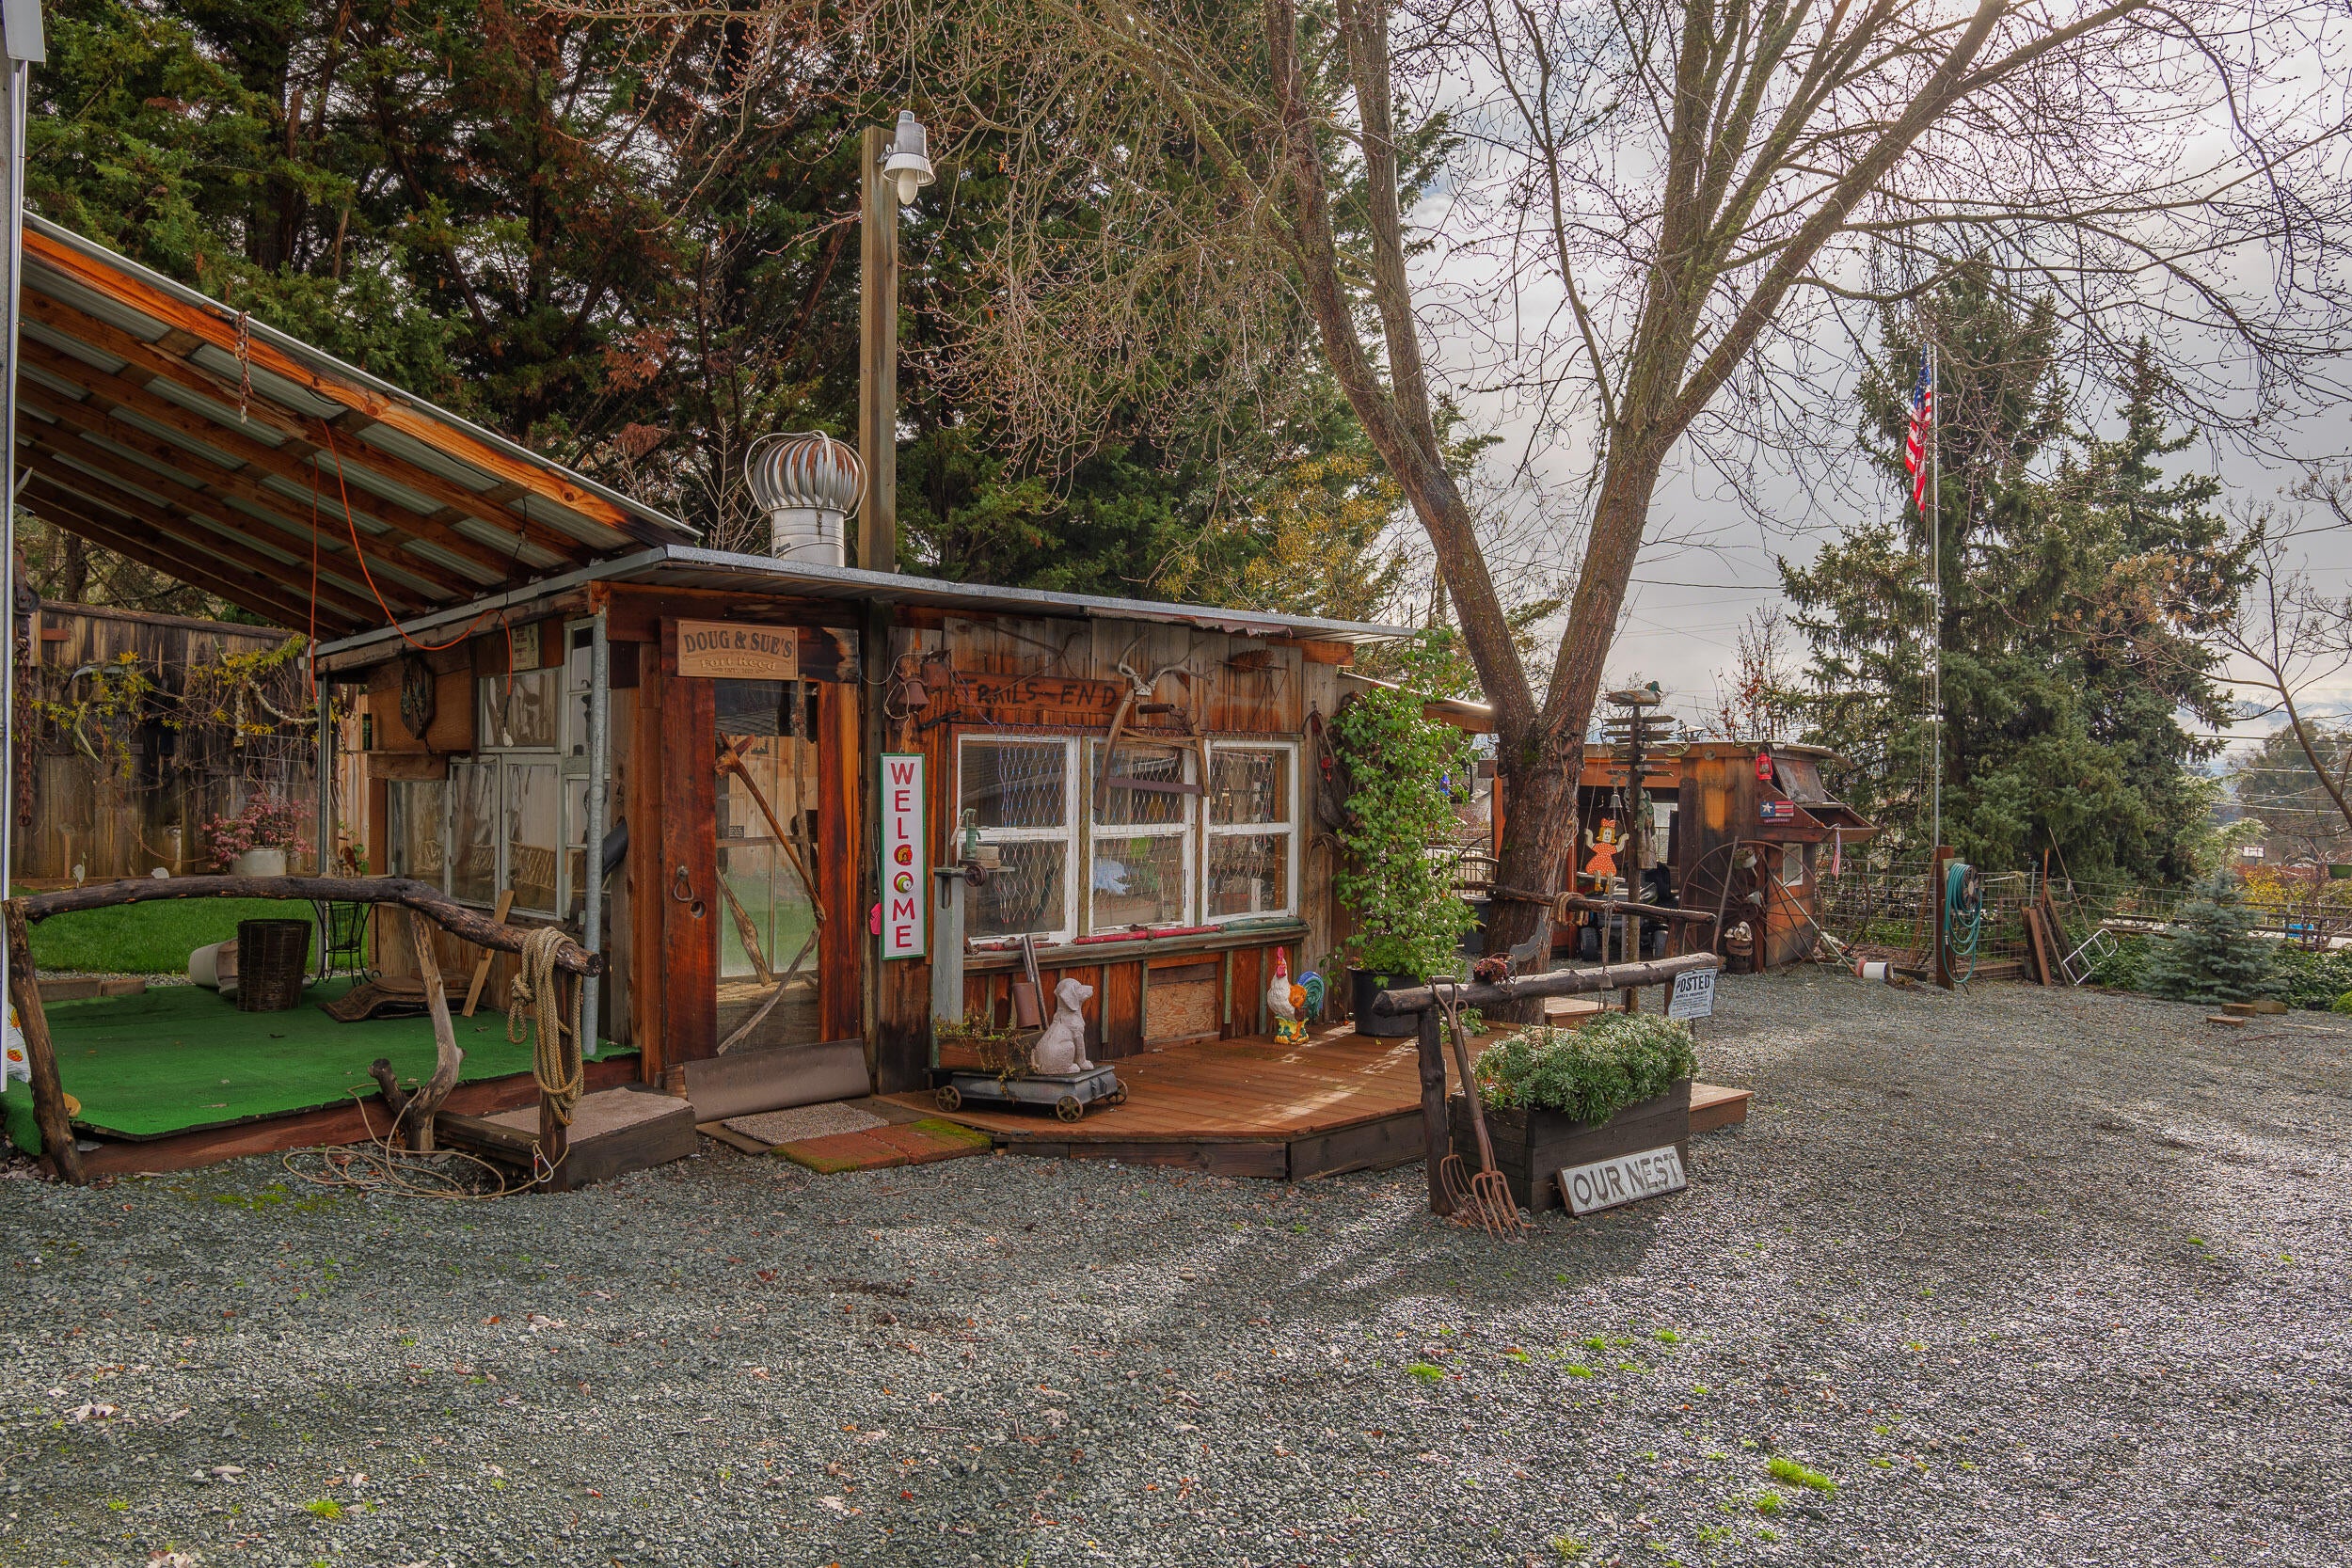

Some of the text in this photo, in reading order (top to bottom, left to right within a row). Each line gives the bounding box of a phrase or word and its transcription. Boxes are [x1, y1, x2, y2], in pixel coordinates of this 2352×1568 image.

[684, 630, 792, 658] DOUG & SUE'S
[890, 762, 915, 949] WELCOME
[1676, 974, 1710, 993] POSTED
[1573, 1152, 1678, 1205] OUR NEST
